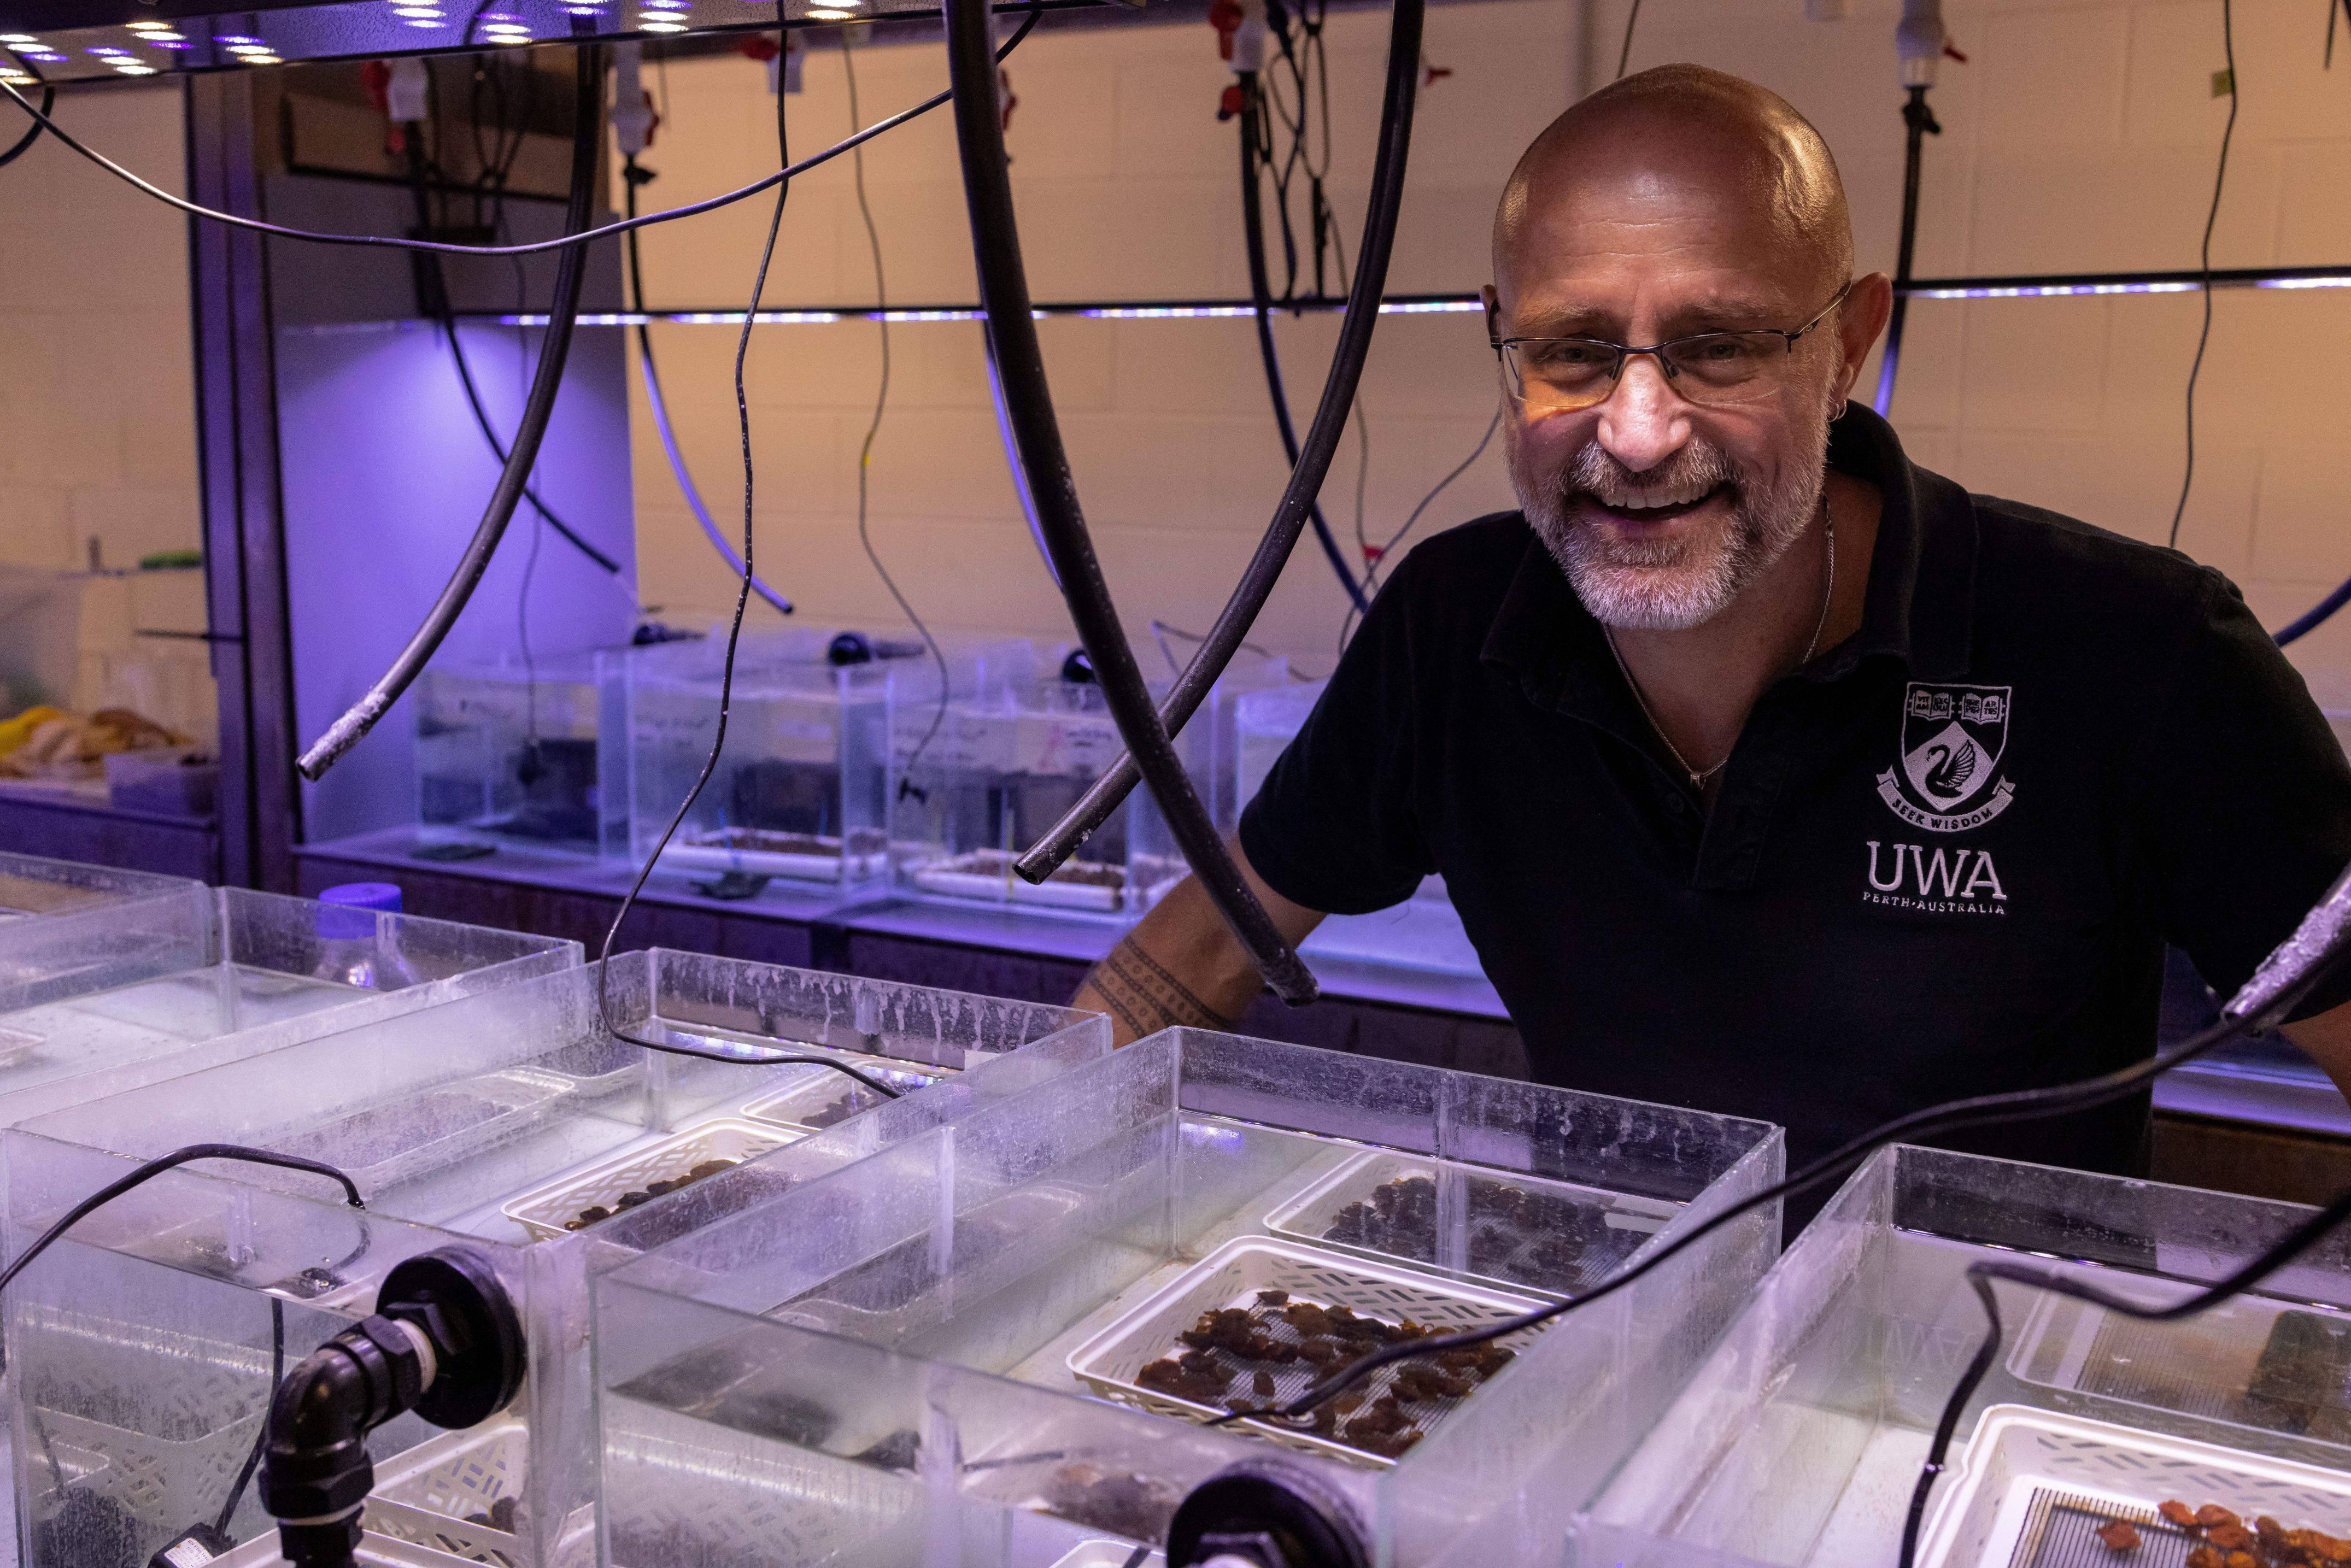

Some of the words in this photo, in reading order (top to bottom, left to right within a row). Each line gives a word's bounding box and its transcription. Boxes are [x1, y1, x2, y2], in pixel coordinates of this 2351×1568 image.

[1892, 798, 1925, 825] SEEK
[1931, 808, 1993, 830] WISDOM
[1866, 841, 2007, 900] UWA
